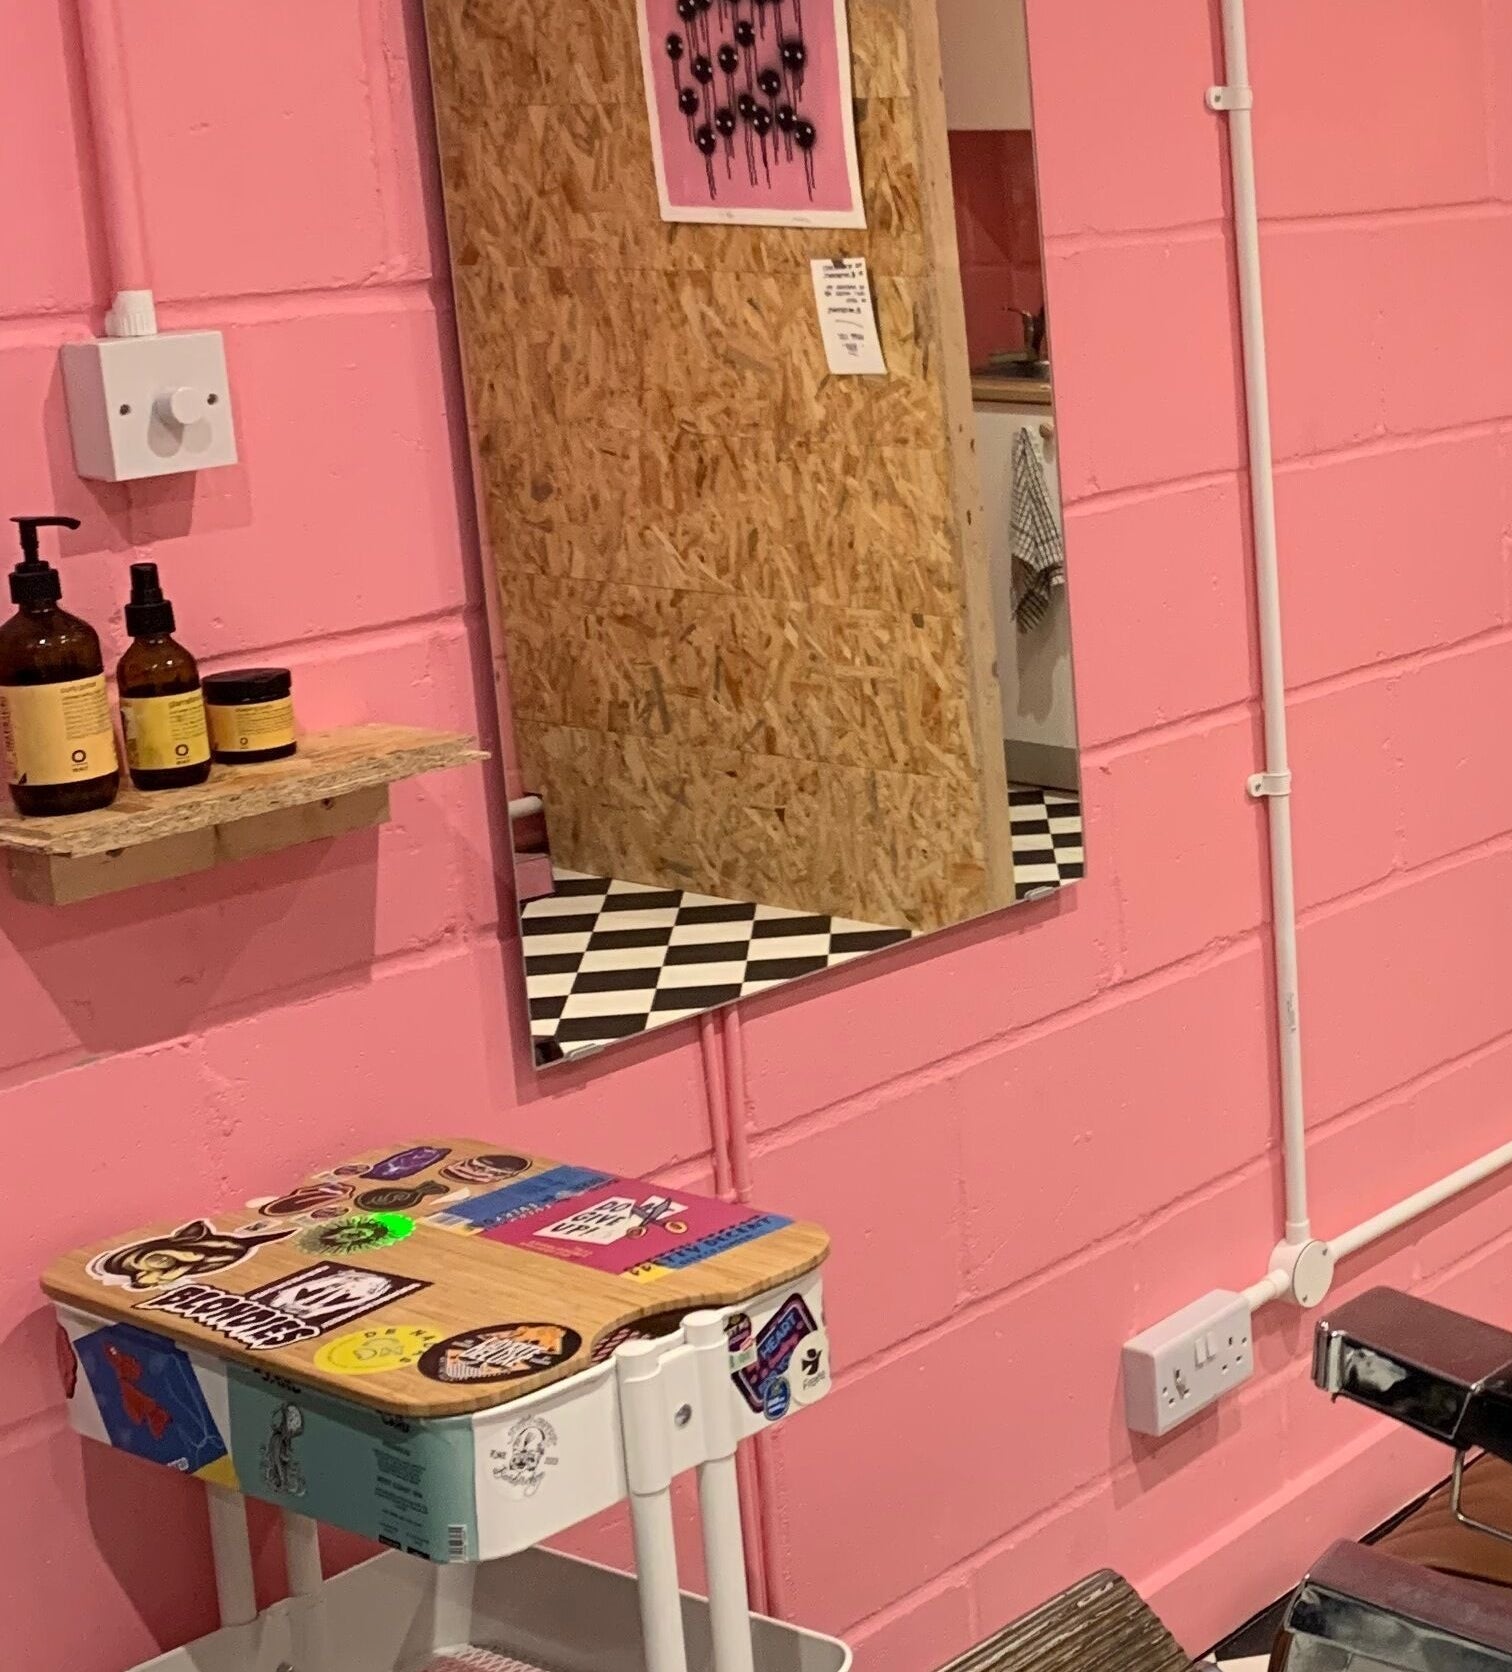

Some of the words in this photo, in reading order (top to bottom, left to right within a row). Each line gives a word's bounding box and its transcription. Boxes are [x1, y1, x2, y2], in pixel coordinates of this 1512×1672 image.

[595, 1200, 632, 1213] DO
[571, 1211, 626, 1227] GIVE
[550, 1222, 600, 1237] UP!
[144, 1284, 320, 1349] BLONDIES
[760, 1311, 797, 1359] HEART
